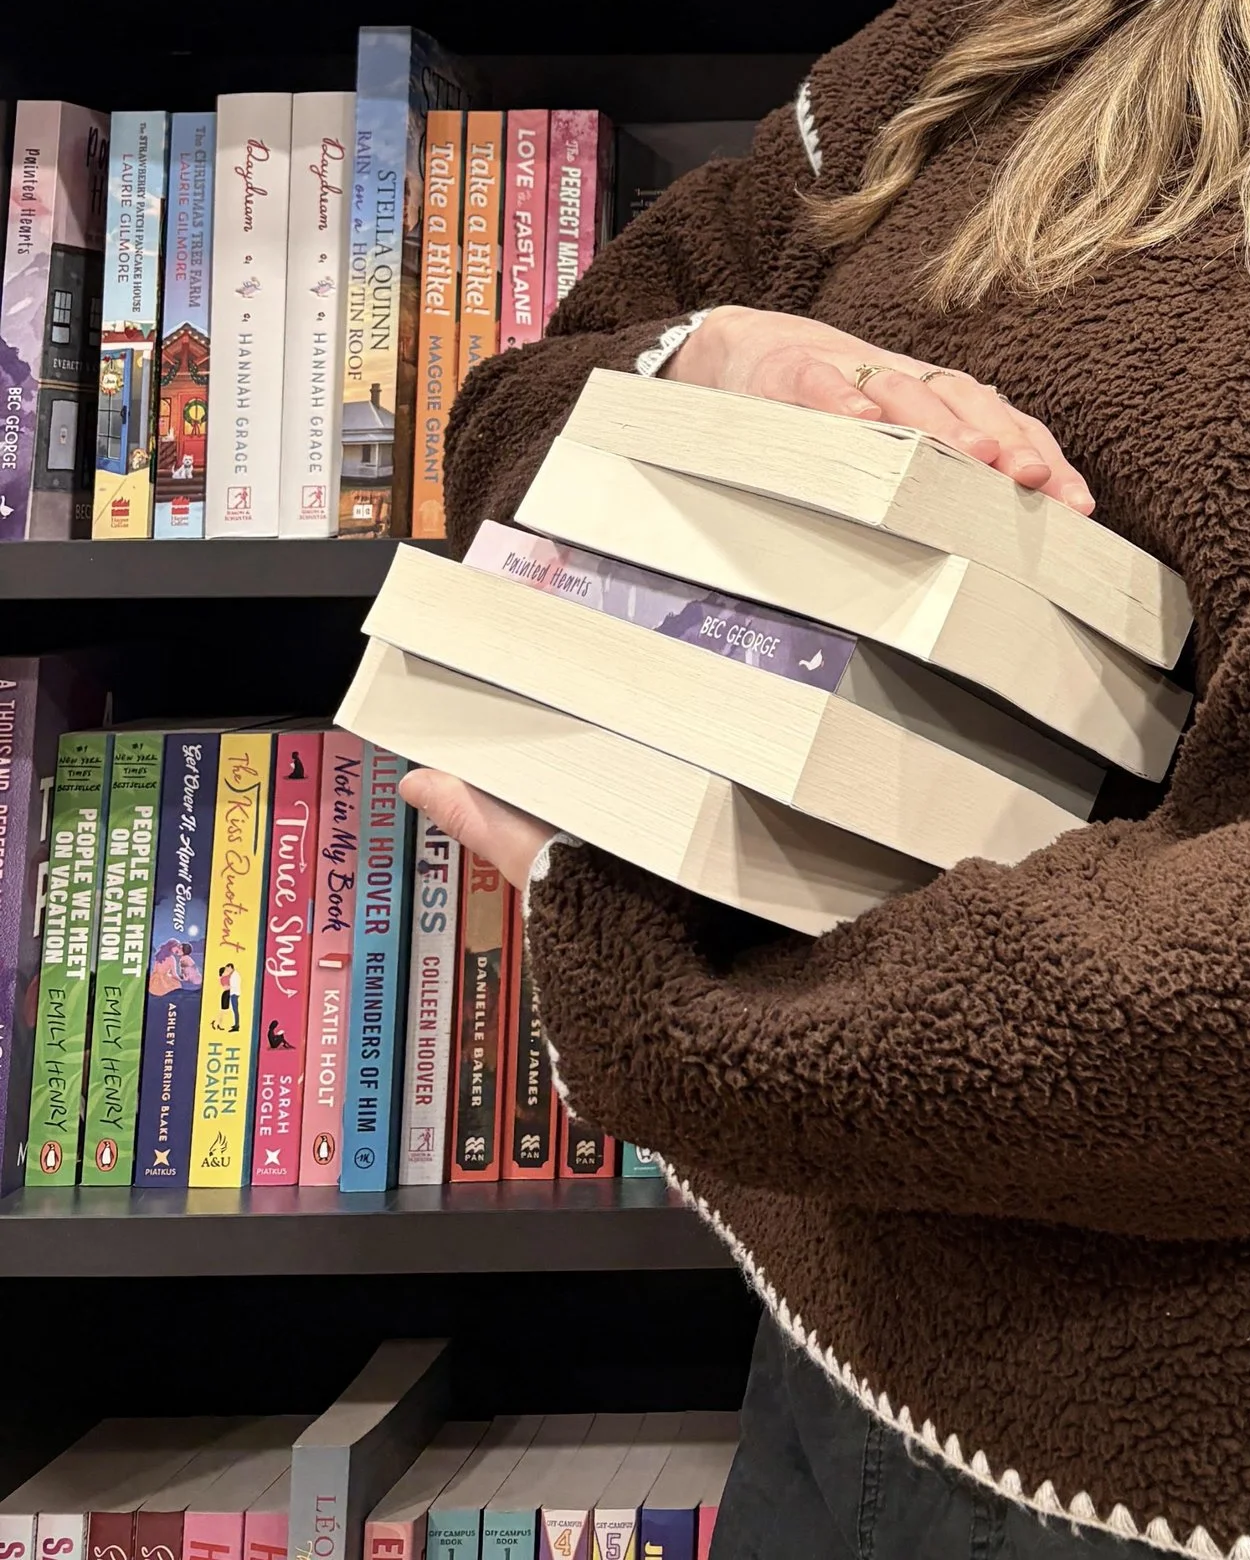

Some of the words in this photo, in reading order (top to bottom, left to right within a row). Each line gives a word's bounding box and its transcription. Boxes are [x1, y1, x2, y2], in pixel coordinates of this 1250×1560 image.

[119, 153, 133, 208] LAURIE
[234, 139, 269, 232] Daydream
[430, 142, 455, 208] Take
[375, 170, 397, 256] STELLA
[430, 215, 445, 233] a
[116, 213, 132, 283] GILMORE
[423, 241, 453, 316] Hike!
[369, 266, 391, 351] QUINN
[235, 334, 252, 410] HANNAH
[234, 417, 249, 475] GRACE
[502, 552, 549, 582] Painted
[550, 568, 592, 598] Hearts
[700, 616, 727, 640] BEC
[727, 624, 780, 658] GEORGE
[112, 829, 129, 855] ON
[129, 805, 153, 881] PEOPLE
[101, 861, 125, 960] VACATION
[127, 884, 147, 919] WE
[123, 924, 144, 978] MEET
[102, 985, 122, 1048] EMILY
[361, 953, 384, 1059] REMINDERS
[419, 956, 440, 1030] COLLEEN
[474, 957, 488, 1041] DANIELLE
[166, 1003, 176, 1046] ASHLEY
[101, 1059, 123, 1129] HENRY
[161, 1051, 173, 1101] HERRING
[204, 1042, 222, 1118] HOANG
[223, 1047, 240, 1113] HELEN
[360, 1067, 379, 1089] OF
[415, 1038, 435, 1106] HOOVER
[471, 1048, 484, 1107] BAKER
[159, 1105, 169, 1142] BLAKE
[357, 1098, 377, 1133] HIM
[145, 1167, 176, 1176] PIATKUS
[201, 1154, 231, 1168] A&U
[465, 1153, 484, 1161] PAN
